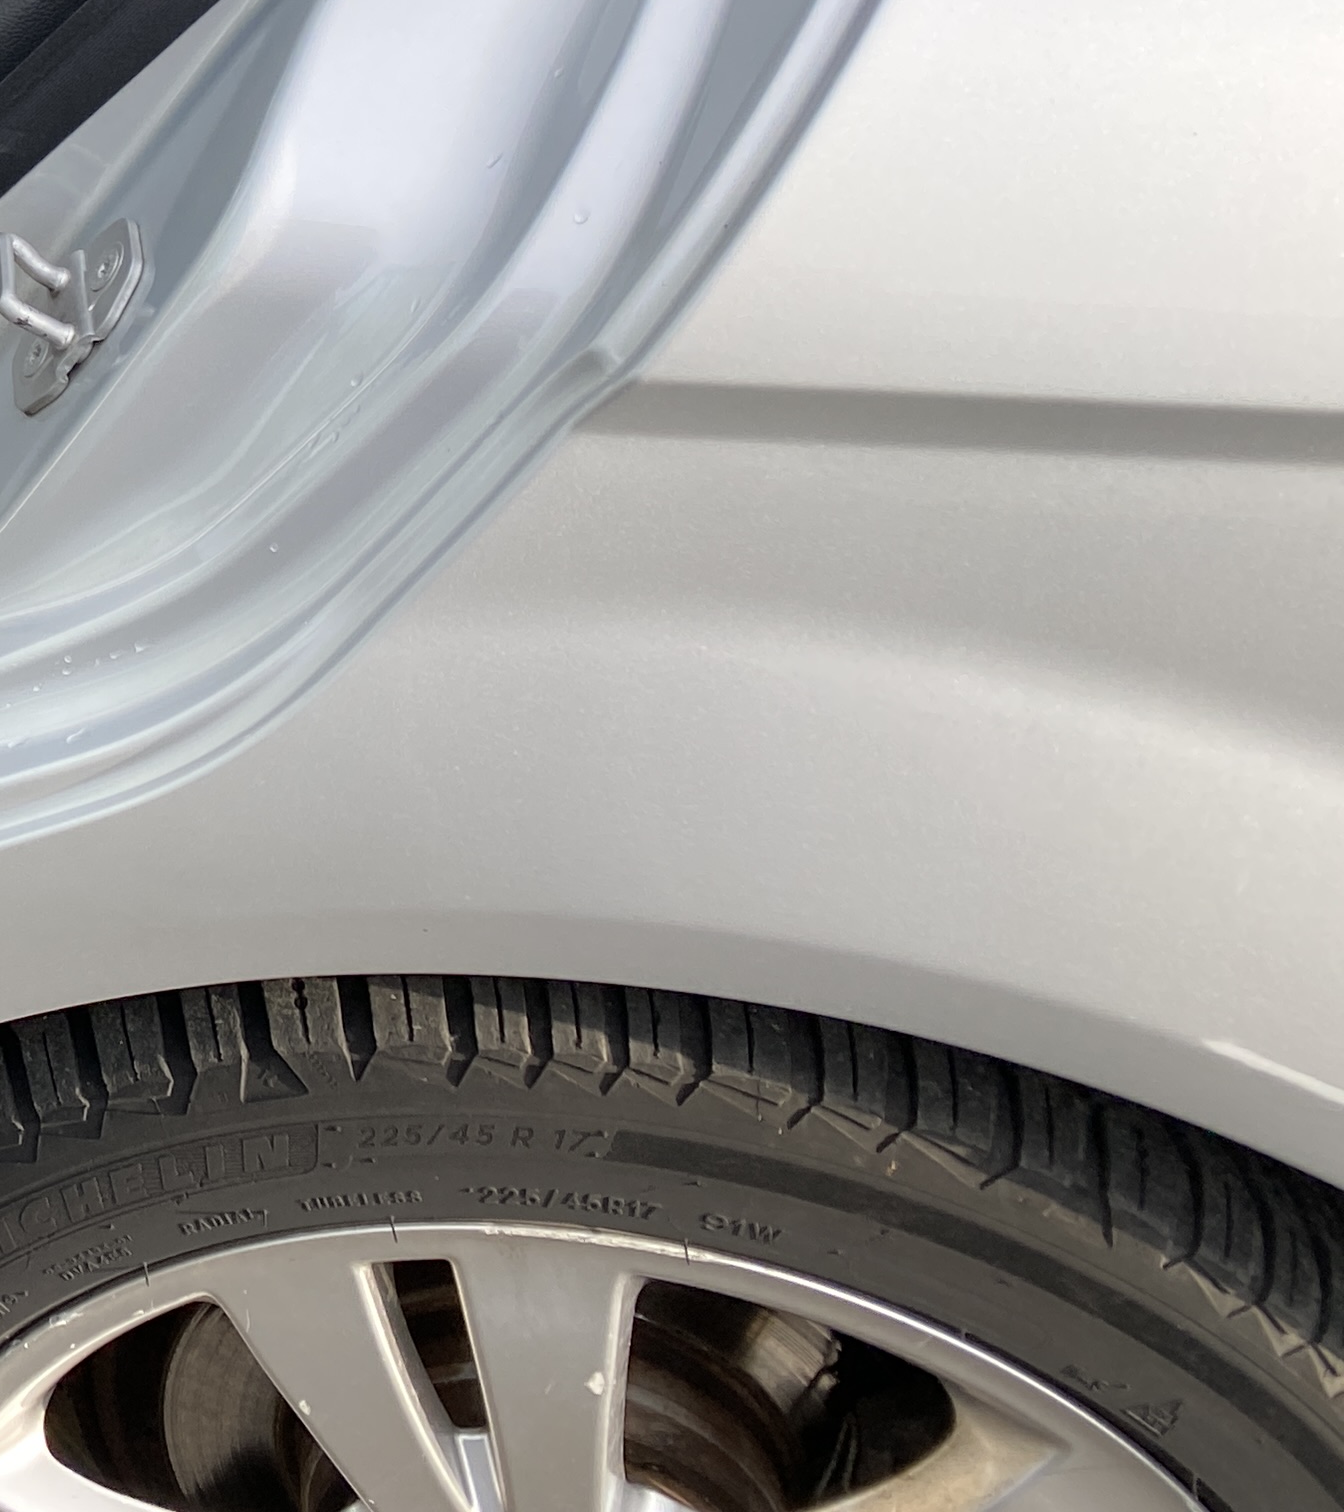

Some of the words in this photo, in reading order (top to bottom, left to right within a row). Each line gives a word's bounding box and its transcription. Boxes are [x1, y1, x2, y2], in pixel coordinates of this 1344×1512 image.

[358, 1123, 496, 1148] 225/45
[511, 1125, 535, 1149] R
[553, 1128, 592, 1153] 17
[177, 1207, 257, 1237] RADIAL
[477, 1187, 664, 1221] 225/45R17
[700, 1211, 788, 1246] 91W
